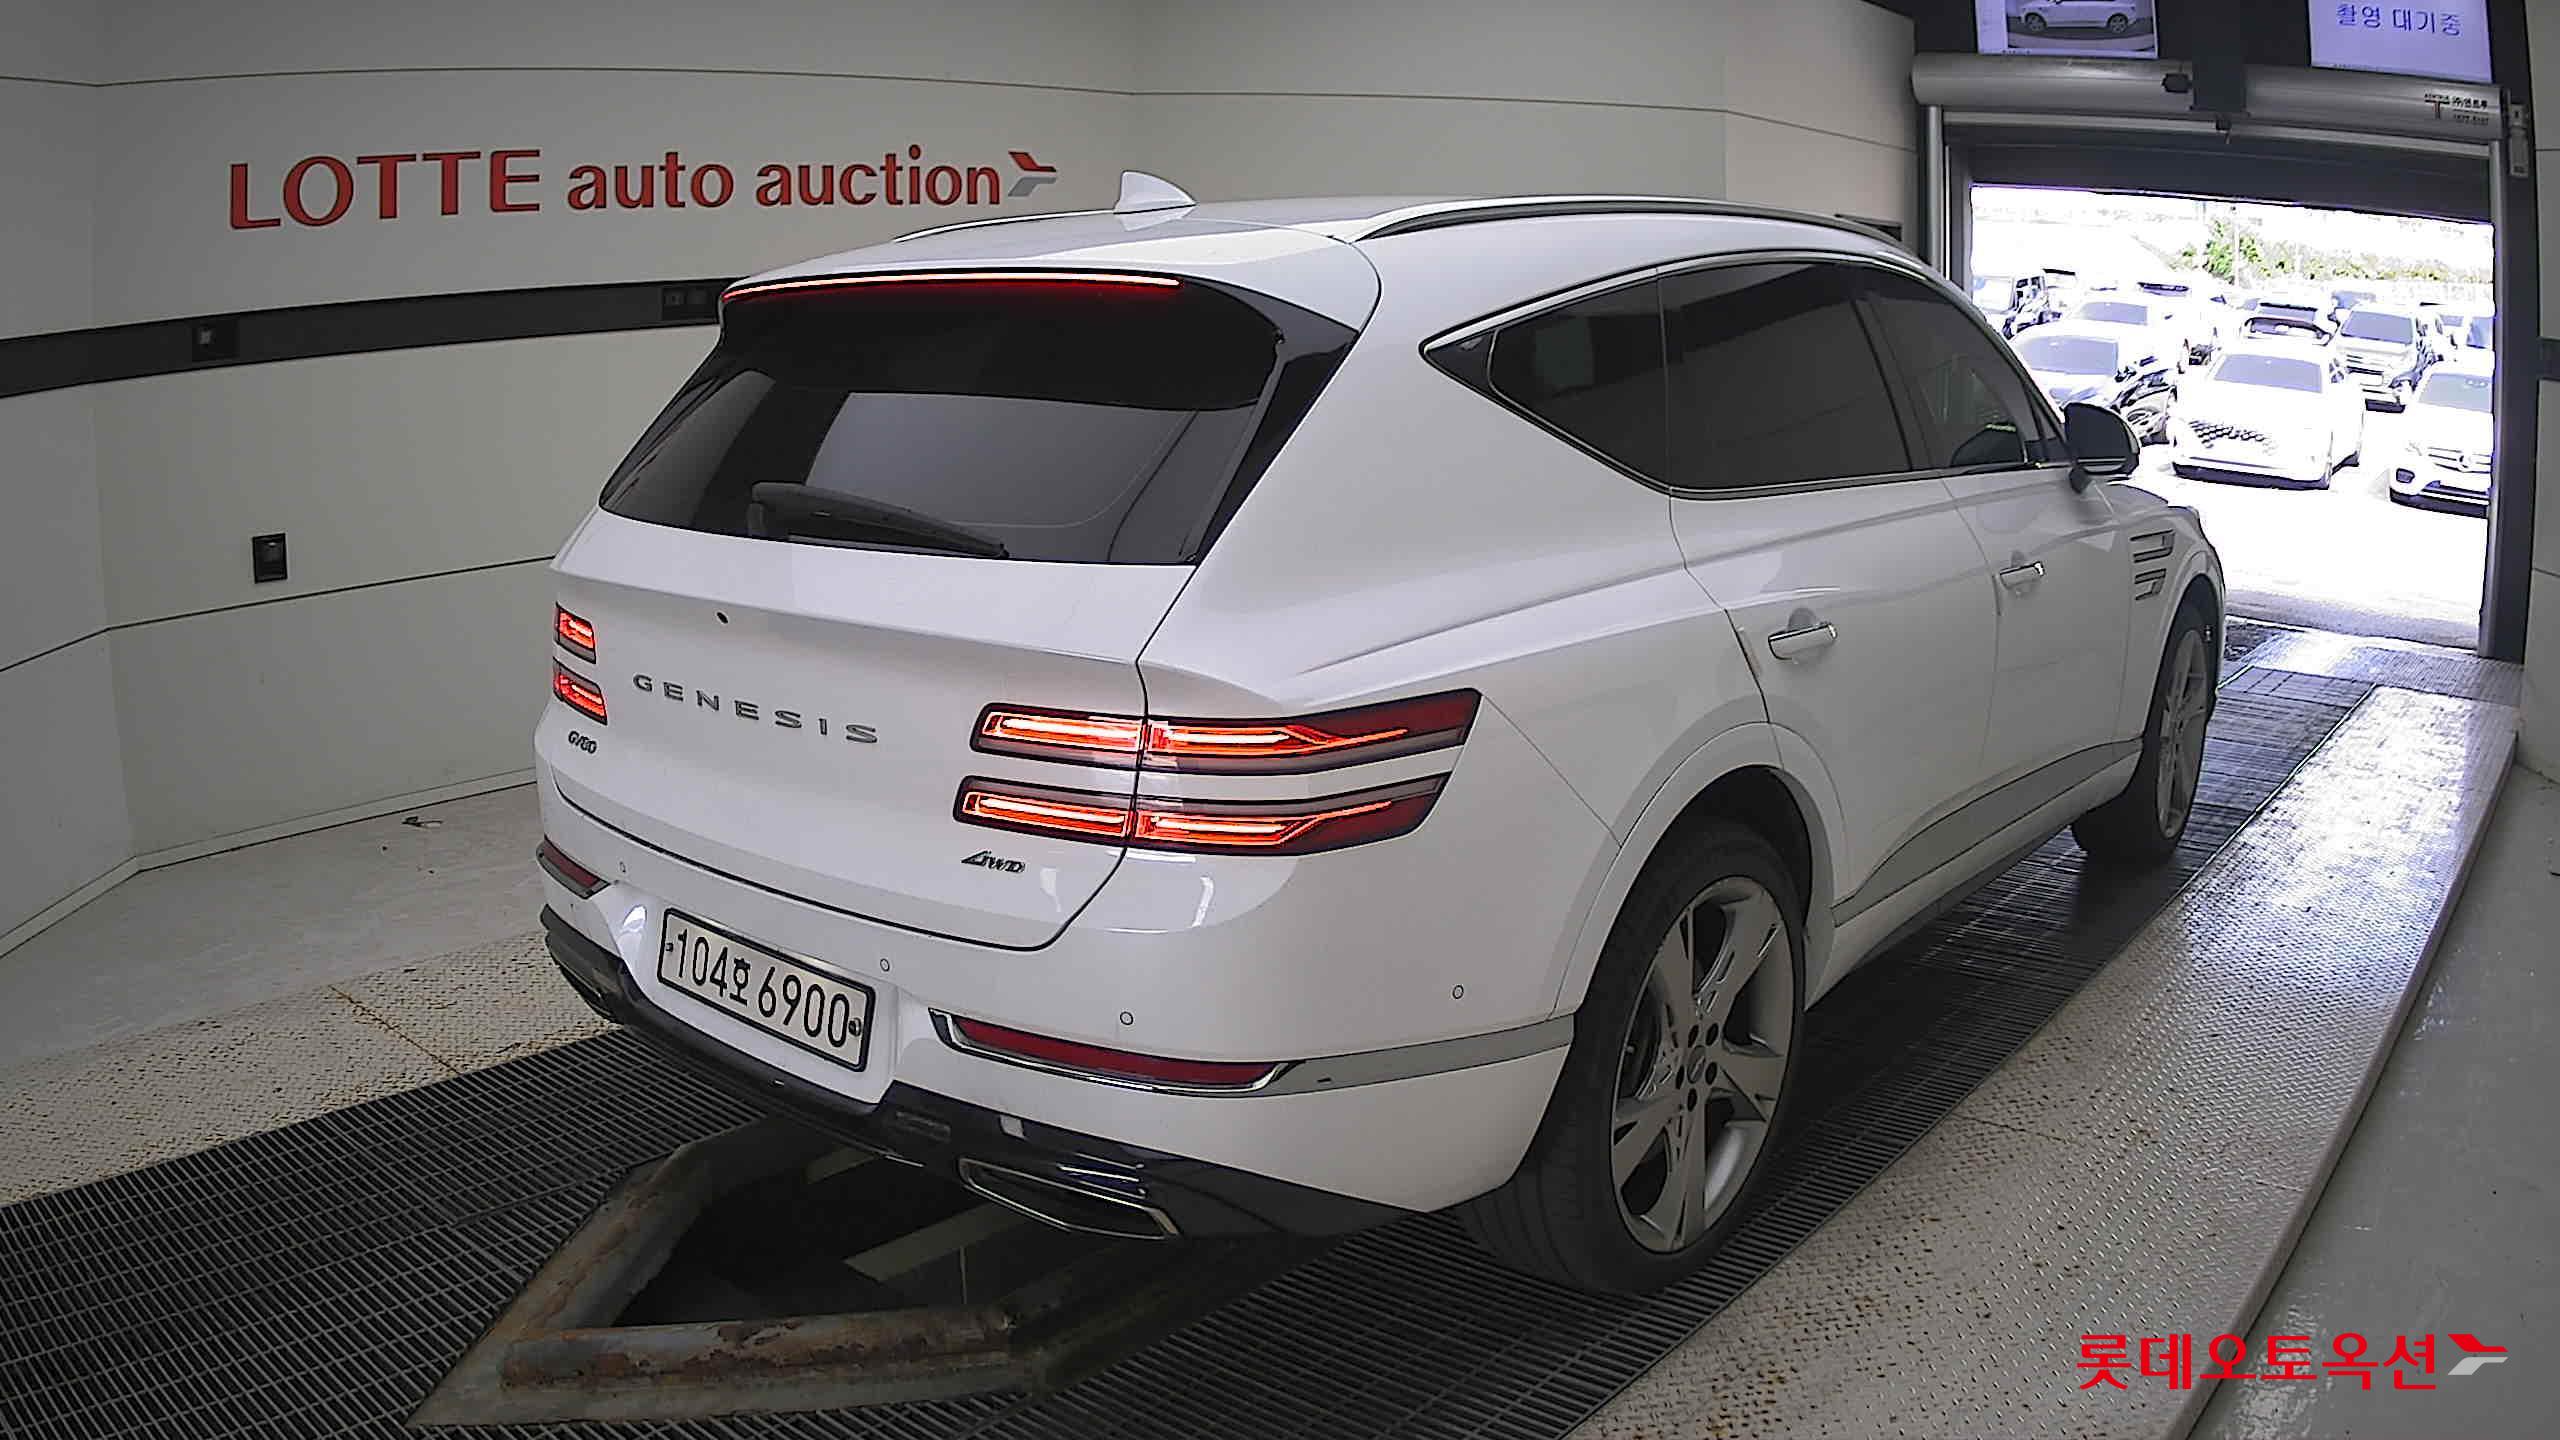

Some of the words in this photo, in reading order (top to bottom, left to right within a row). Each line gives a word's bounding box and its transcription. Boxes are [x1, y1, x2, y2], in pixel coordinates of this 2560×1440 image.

[2336, 4, 2381, 29] 촬영
[2392, 8, 2462, 37] 대기중
[229, 149, 542, 231] LOTTE
[567, 150, 735, 210] auto
[755, 144, 1002, 207] auction
[632, 673, 878, 744] GENESIS
[677, 928, 751, 1007] 104호
[758, 966, 850, 1048] 6900
